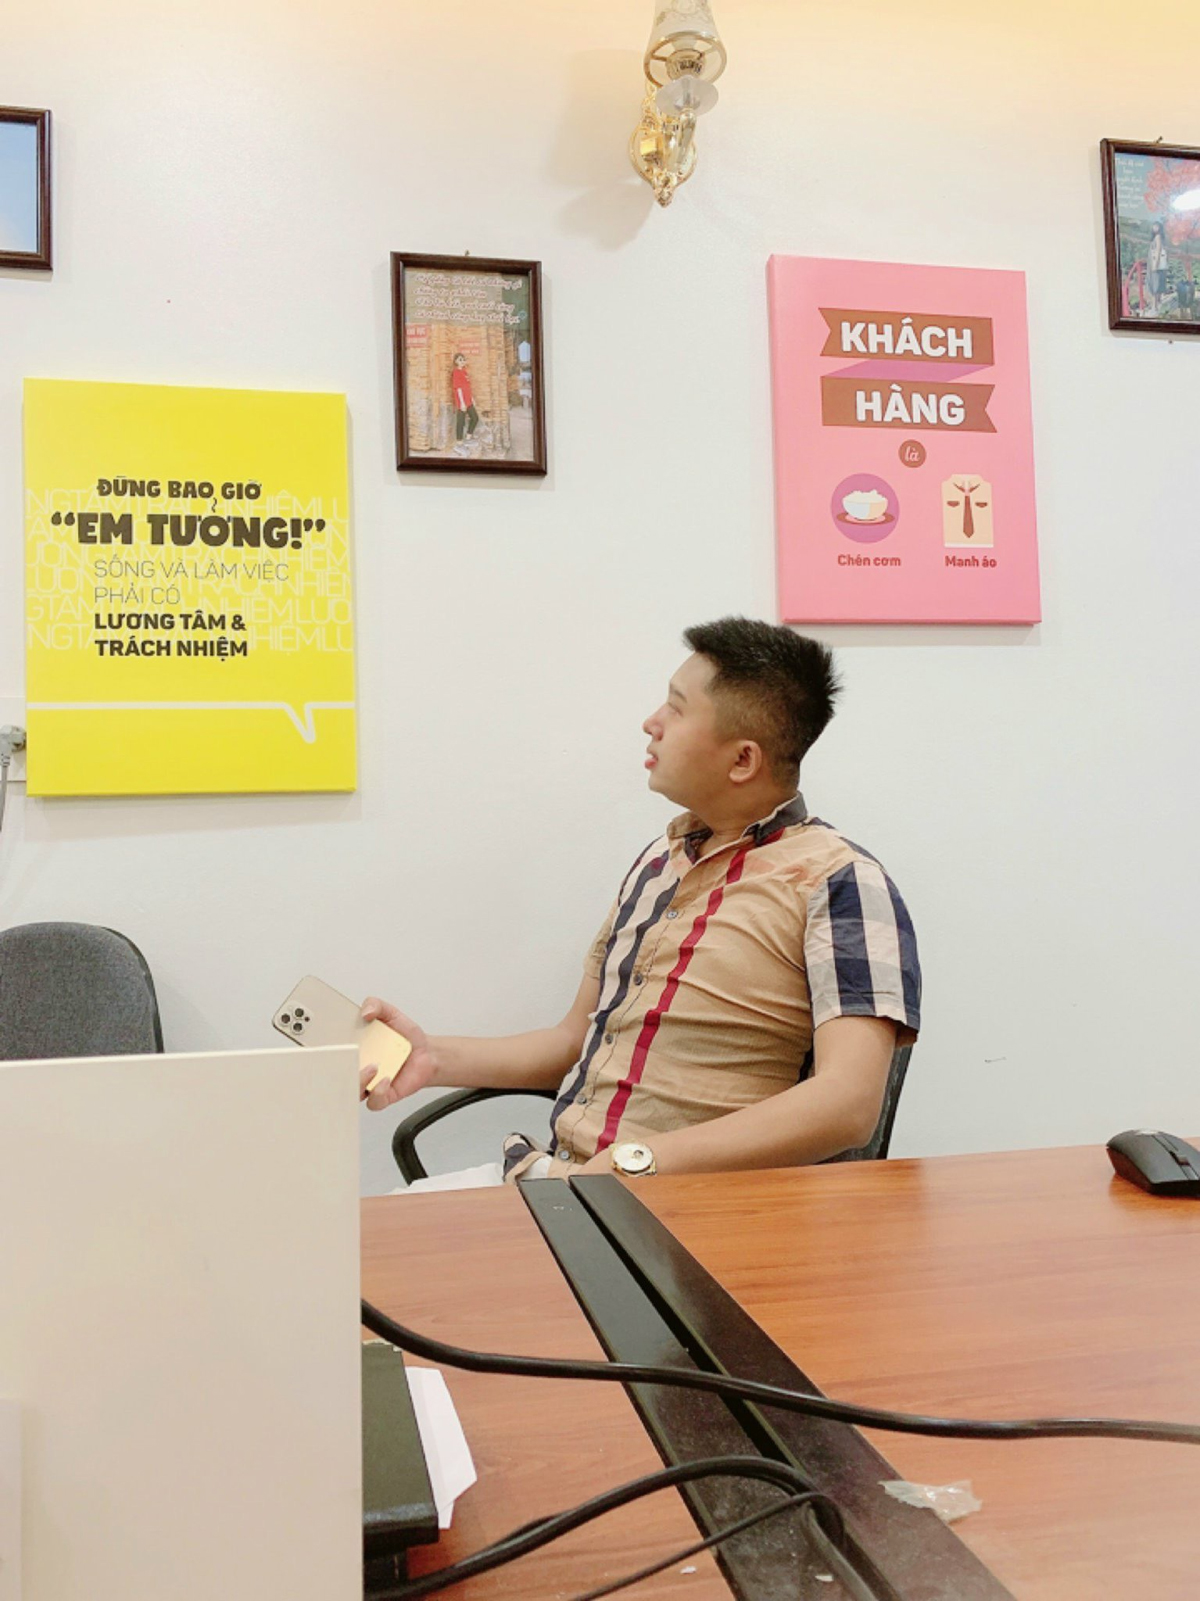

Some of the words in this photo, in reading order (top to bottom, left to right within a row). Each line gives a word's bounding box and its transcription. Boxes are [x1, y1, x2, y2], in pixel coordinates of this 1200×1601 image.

[841, 317, 973, 358] KHÁCH
[856, 383, 965, 426] HÀNG
[904, 445, 920, 462] là
[168, 481, 214, 499] BAO
[94, 554, 155, 578] SỐNG
[161, 558, 188, 578] VÀ
[194, 558, 238, 580] LÀM
[243, 559, 289, 583] VIỆC
[837, 554, 871, 566] Chén
[873, 556, 902, 567] cơm
[982, 555, 997, 568] áo
[94, 583, 145, 604] PHẢI
[151, 584, 181, 605] CÓ
[95, 613, 175, 630] LƯƠNG
[180, 609, 226, 630] TÂM
[231, 614, 247, 631] &
[95, 635, 171, 656] TRÁCH
[177, 636, 248, 662] NHIỆM
